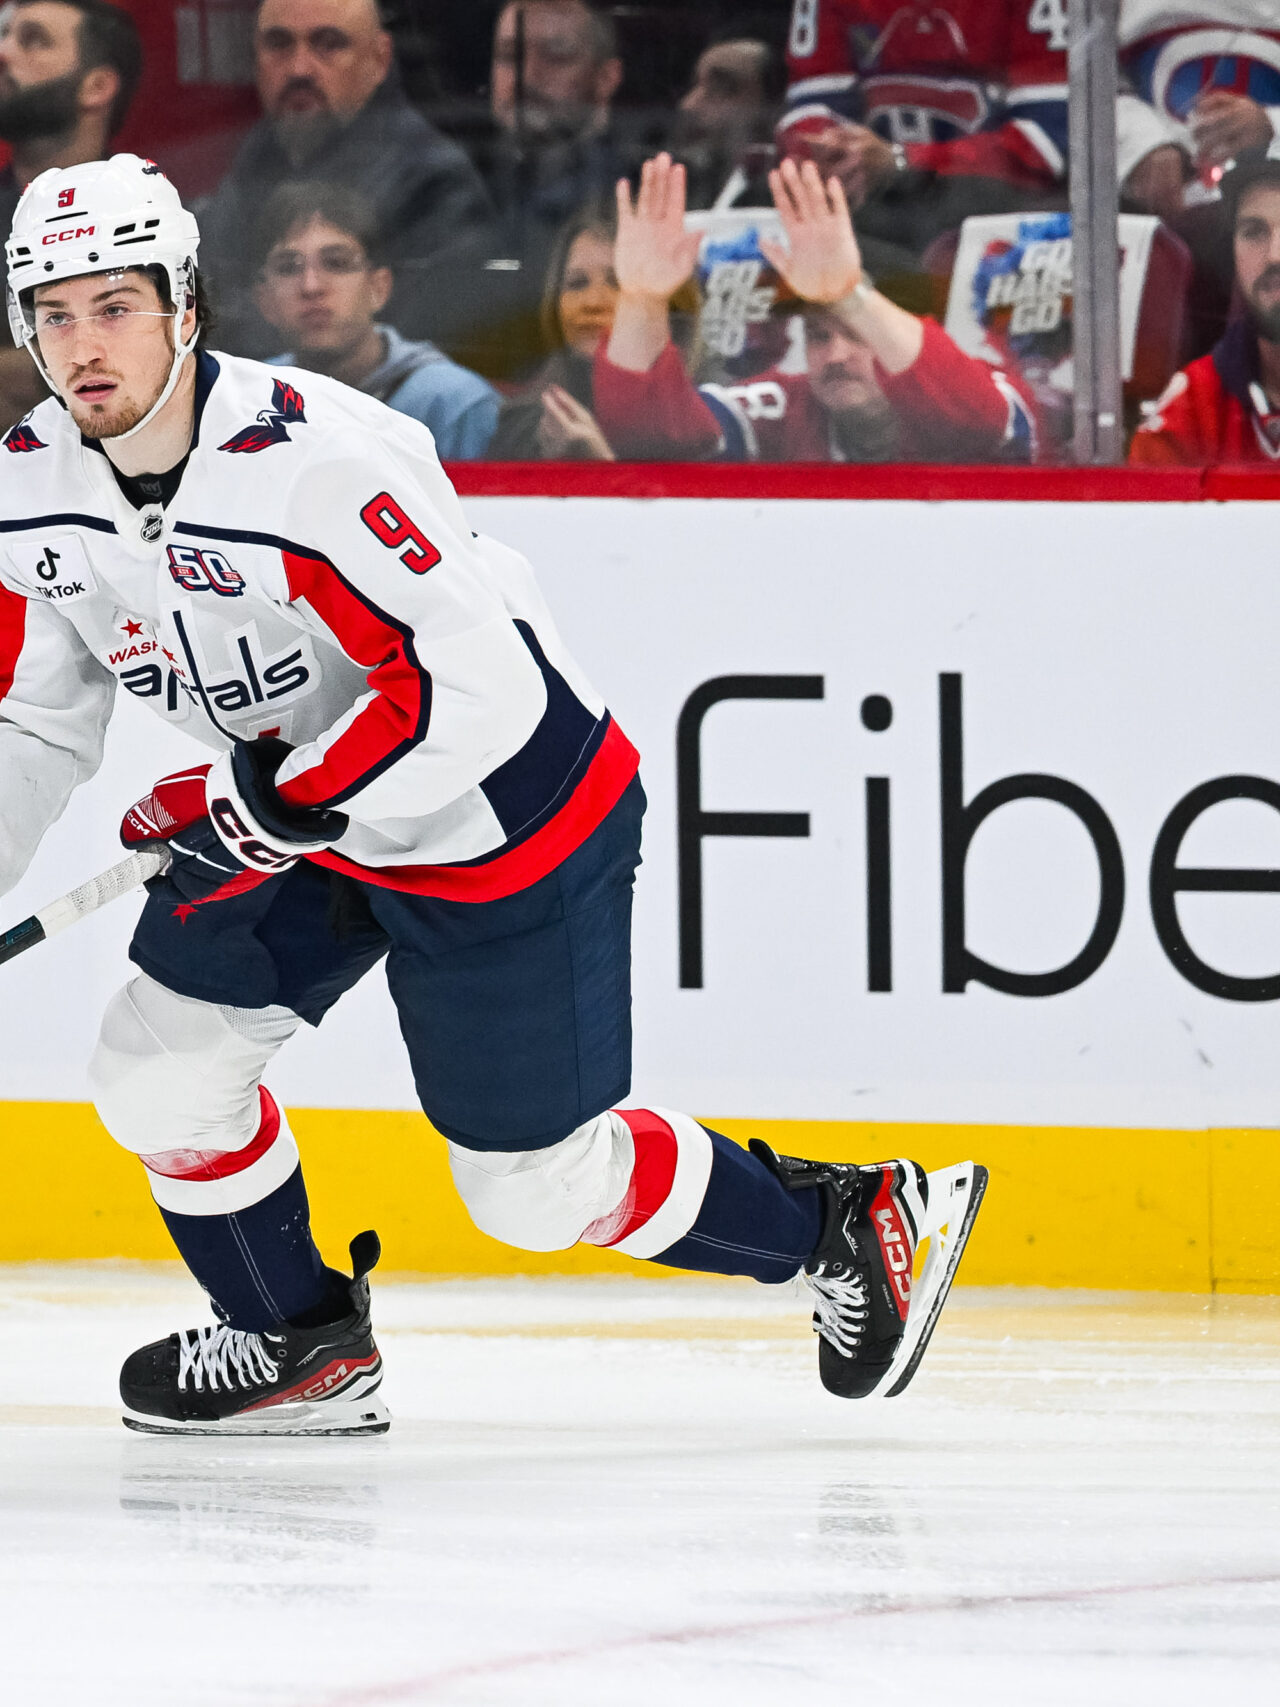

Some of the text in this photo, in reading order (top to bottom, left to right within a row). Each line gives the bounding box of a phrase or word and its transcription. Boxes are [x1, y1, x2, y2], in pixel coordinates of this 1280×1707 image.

[58, 188, 76, 208] 9
[42, 225, 95, 246] CCM
[360, 491, 441, 575] 9
[166, 544, 246, 597] 50
[126, 812, 151, 836] CCM
[676, 671, 1280, 1004] Fibe
[874, 1208, 912, 1302] CCM
[282, 1363, 348, 1404] CCM
